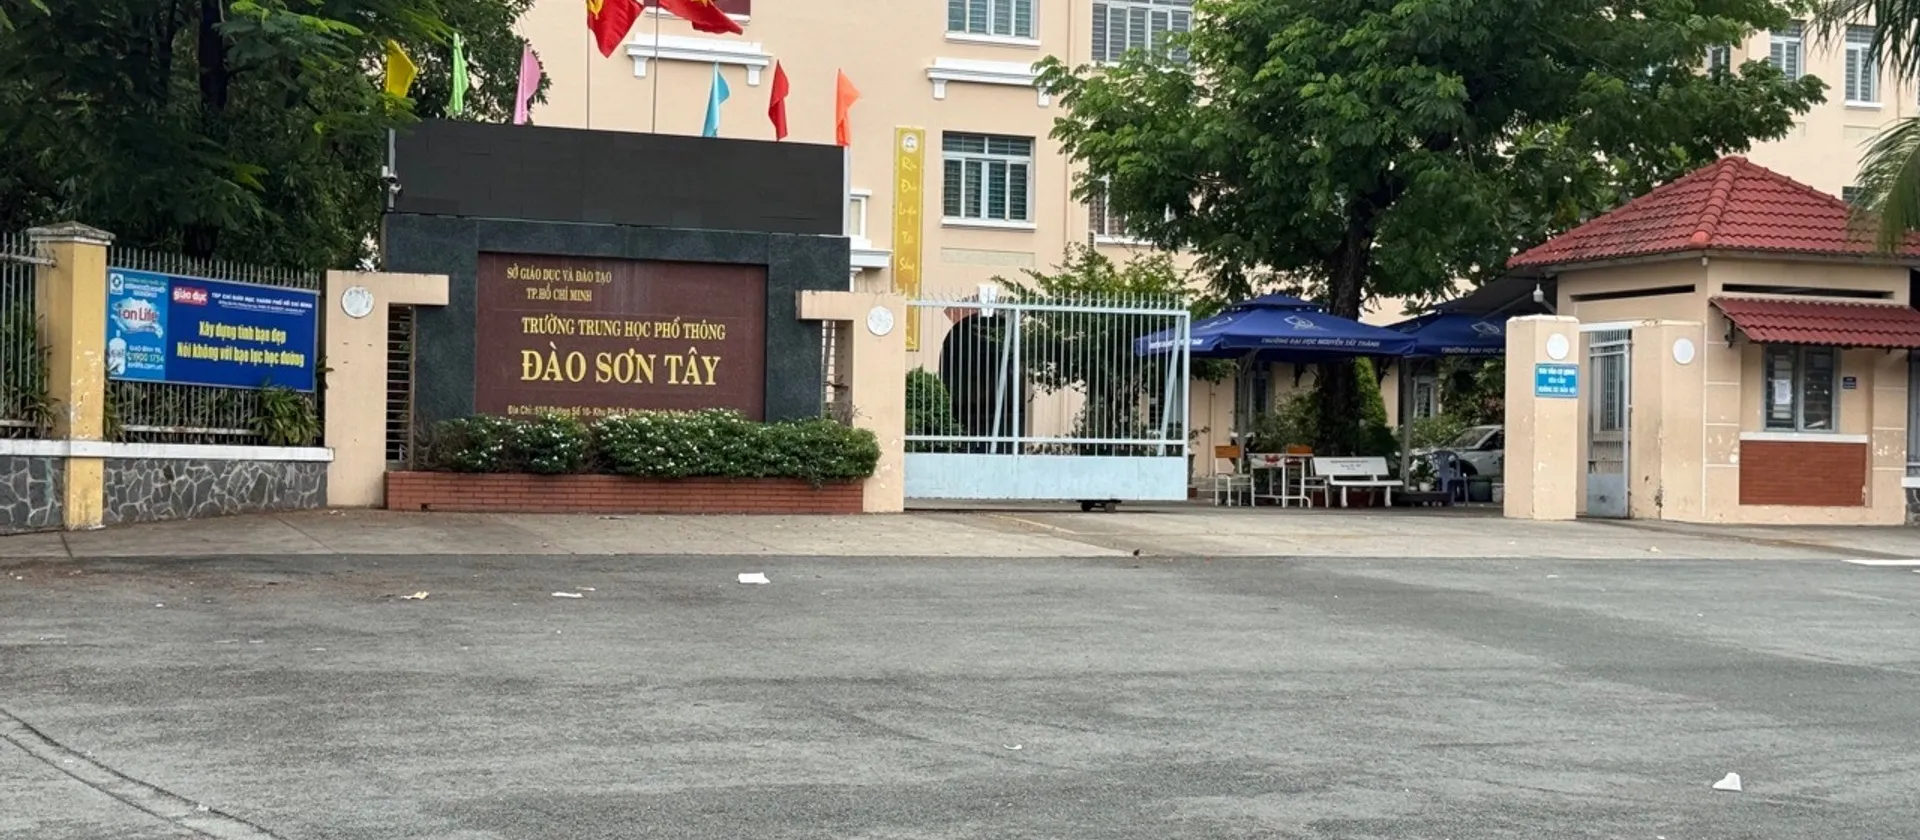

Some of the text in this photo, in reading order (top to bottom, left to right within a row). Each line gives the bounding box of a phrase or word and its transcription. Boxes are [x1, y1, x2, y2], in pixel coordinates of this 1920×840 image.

[520, 265, 542, 280] GIÁO
[543, 268, 560, 283] DỤC
[562, 267, 574, 281] VÀ
[575, 268, 594, 282] ĐÀO
[595, 271, 612, 285] TẠO
[553, 286, 569, 300] CHÍ
[570, 289, 592, 301] MINH
[199, 320, 215, 338] Xây
[237, 324, 254, 340] tình
[271, 328, 287, 346] đẹp
[521, 314, 726, 340] TRƯỜNG TRUNG HỌC PHỔ THÔNG
[177, 341, 191, 358] Nói
[192, 343, 219, 361] không
[264, 349, 279, 368] học
[520, 341, 721, 386] ĐÀO SƠN TÂY
